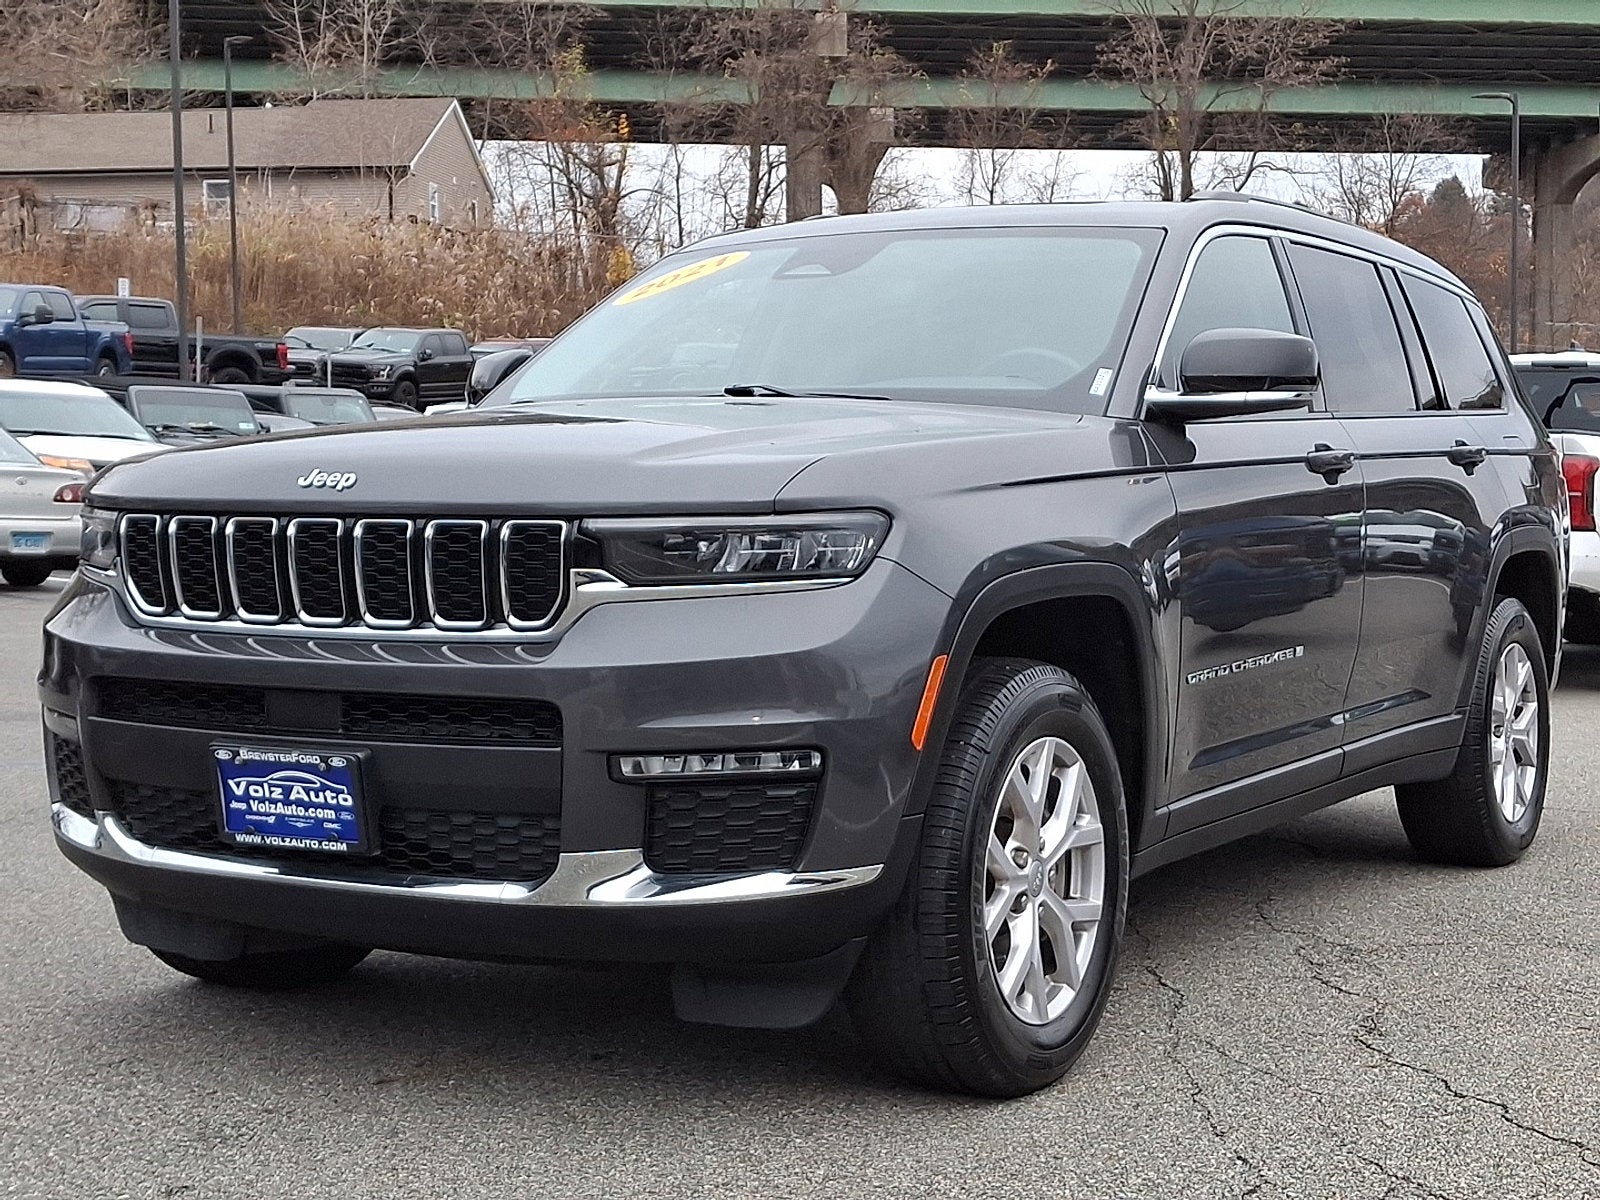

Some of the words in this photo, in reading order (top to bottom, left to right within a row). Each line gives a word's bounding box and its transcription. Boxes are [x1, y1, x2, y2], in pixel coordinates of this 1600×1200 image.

[630, 255, 730, 299] 2021
[297, 468, 357, 492] Jeep
[1186, 663, 1229, 684] GRAND
[1231, 647, 1295, 673] CHEROKEE
[227, 779, 284, 799] Volz
[289, 785, 353, 806] Auto
[249, 799, 336, 820] VolzAuto.com
[235, 833, 348, 851] WWW.VOLZAUTO.COM
